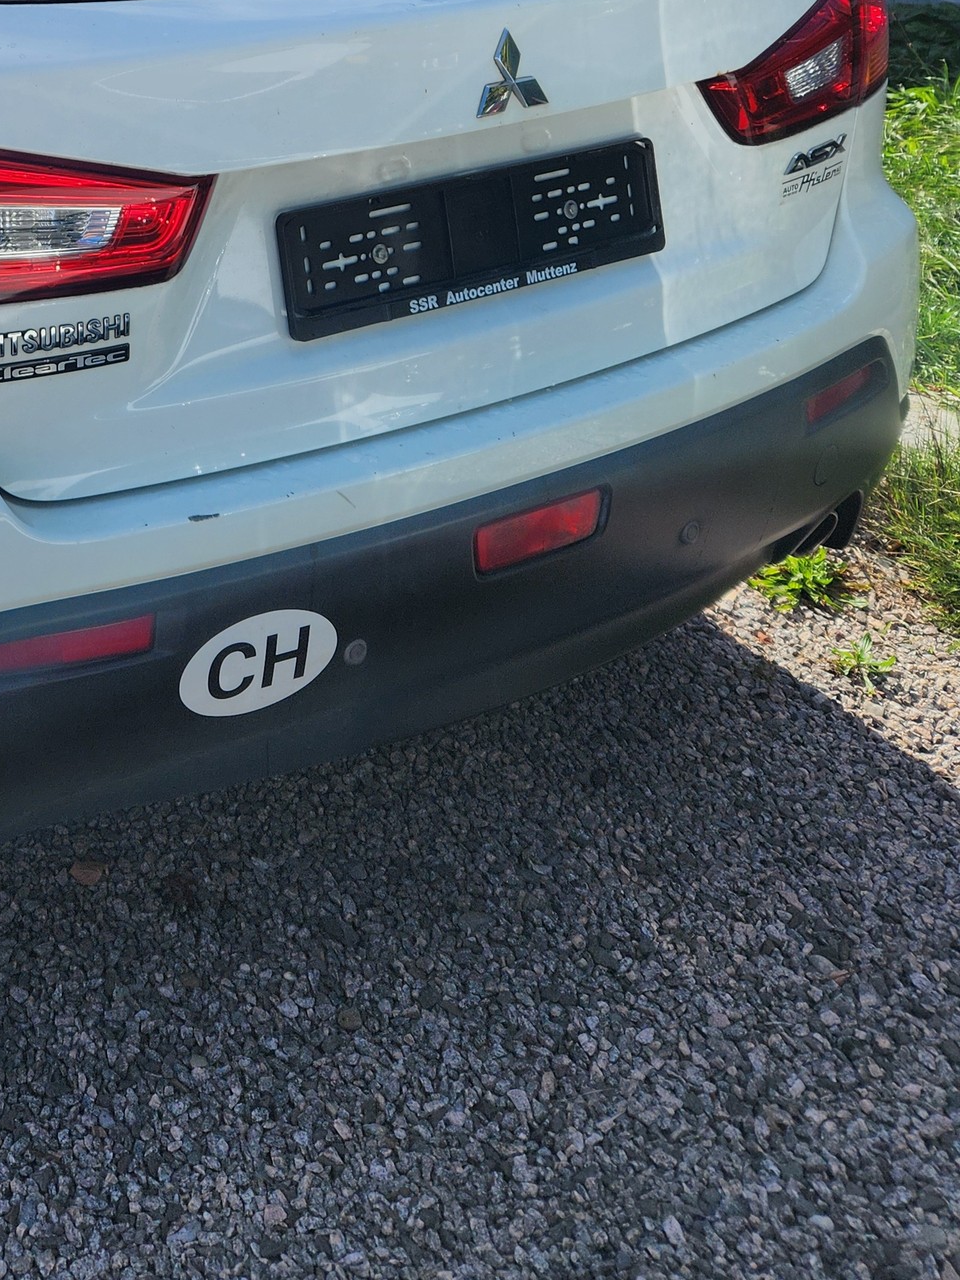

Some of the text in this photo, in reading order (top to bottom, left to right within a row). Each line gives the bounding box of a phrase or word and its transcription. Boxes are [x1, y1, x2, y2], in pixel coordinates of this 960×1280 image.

[783, 133, 848, 176] ASX
[783, 184, 799, 195] AUTO
[409, 262, 578, 314] SSR Autocenter Muttenz
[208, 625, 311, 700] CH
